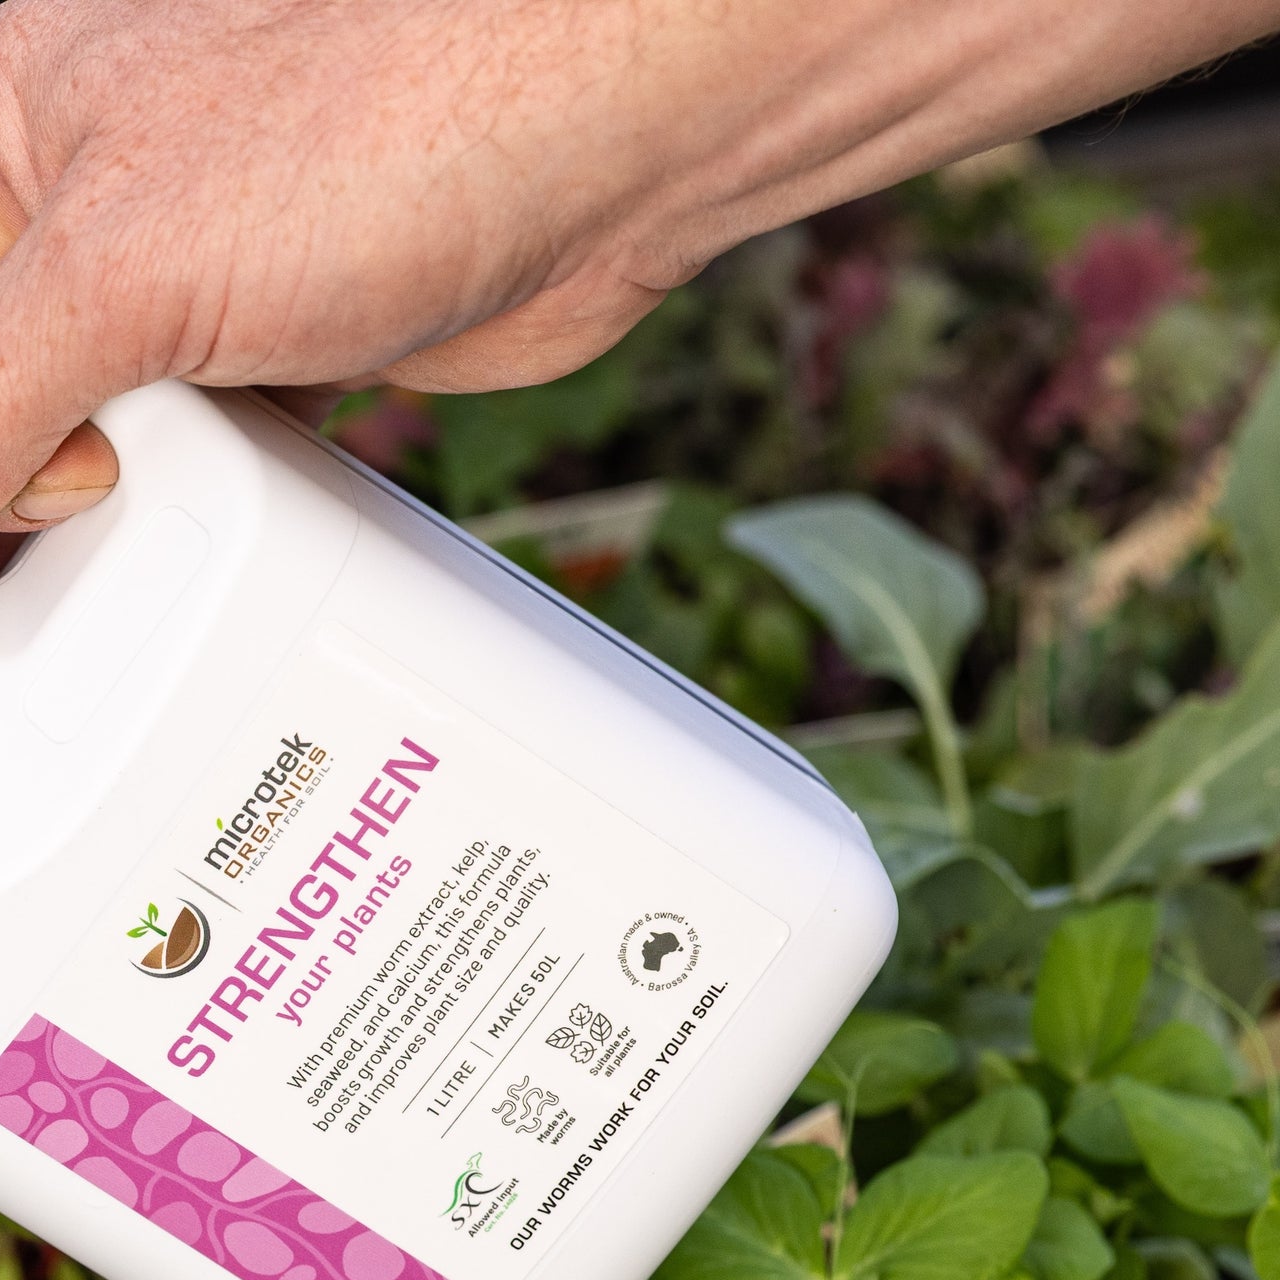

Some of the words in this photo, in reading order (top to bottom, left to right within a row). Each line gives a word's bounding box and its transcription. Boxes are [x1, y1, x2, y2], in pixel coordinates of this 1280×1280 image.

[203, 731, 313, 871] microtek
[223, 746, 327, 880] ORGANICS
[244, 826, 285, 877] HEALTH
[282, 798, 306, 825] FOR
[304, 766, 331, 796] SOIL
[166, 736, 441, 1078] STRENGTHEN
[622, 918, 645, 942] made
[644, 912, 653, 923] &
[653, 911, 686, 924] owned
[686, 927, 699, 943] SA
[275, 954, 333, 1028] your
[332, 855, 413, 956] plants
[286, 1054, 325, 1089] With
[319, 984, 379, 1056] premium
[372, 939, 413, 984] worm
[408, 879, 461, 939] extract,
[451, 840, 490, 877] kelp,
[616, 942, 641, 986] Australian
[683, 943, 702, 972] Valley
[306, 1037, 369, 1108] seaweed,
[362, 1002, 392, 1037] and
[386, 943, 442, 1006] calcium,
[434, 907, 466, 939] this
[457, 844, 512, 907] formula
[312, 1080, 362, 1133] boosts
[357, 1026, 405, 1082] growth
[400, 992, 429, 1026] and
[423, 900, 500, 995] strengthens
[494, 848, 542, 903] plants,
[344, 1101, 373, 1134] and
[363, 1033, 427, 1105] improves
[422, 992, 460, 1037] plant
[454, 960, 484, 993] size
[479, 926, 508, 961] and
[503, 872, 551, 928] quality.
[487, 983, 536, 1039] MAKES
[529, 955, 561, 983] 50L
[647, 972, 689, 992] Barossa
[589, 1040, 622, 1077] Suitable
[616, 1025, 631, 1041] for
[604, 1064, 617, 1078] all
[612, 1037, 637, 1068] plants
[426, 1106, 440, 1117] 1
[433, 1059, 477, 1108] LITRE
[509, 1216, 543, 1251] OUR
[536, 1153, 593, 1215] WORMS
[587, 1100, 635, 1152] WORK
[628, 1067, 661, 1102] FOR
[654, 1020, 697, 1065] YOUR
[691, 981, 729, 1020] SOIL.
[536, 1119, 560, 1144] Made
[554, 1107, 569, 1121] by
[549, 1116, 577, 1146] worms
[467, 1201, 500, 1239] Allowed
[495, 1177, 520, 1203] Input
